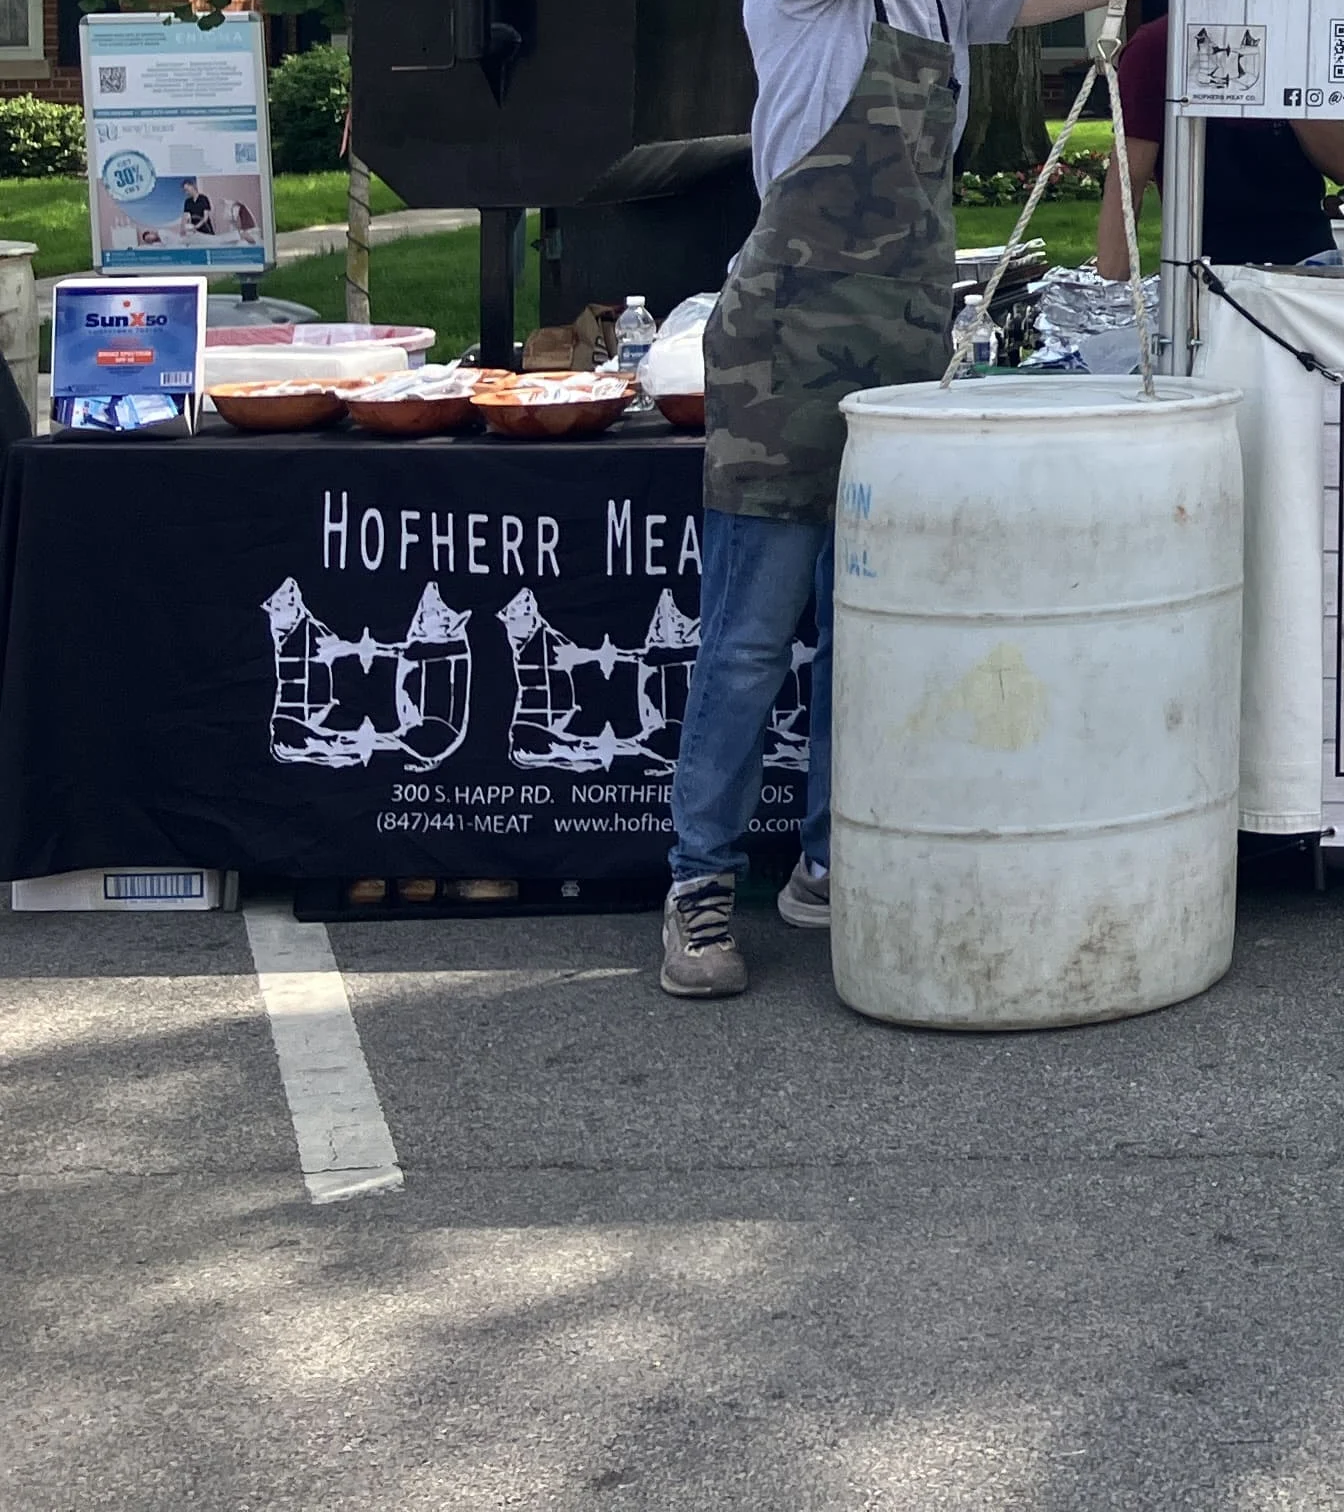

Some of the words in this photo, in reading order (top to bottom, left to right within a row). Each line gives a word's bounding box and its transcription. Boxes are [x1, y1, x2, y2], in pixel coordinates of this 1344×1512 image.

[322, 490, 561, 578] HOFHERR
[606, 497, 702, 576] MEA
[391, 784, 430, 804] 300
[433, 785, 452, 804] S.
[456, 786, 515, 805] HAPP
[520, 786, 555, 805] RD.
[572, 785, 672, 805] NORTHFIE
[376, 812, 533, 834] (847)441-MEAT
